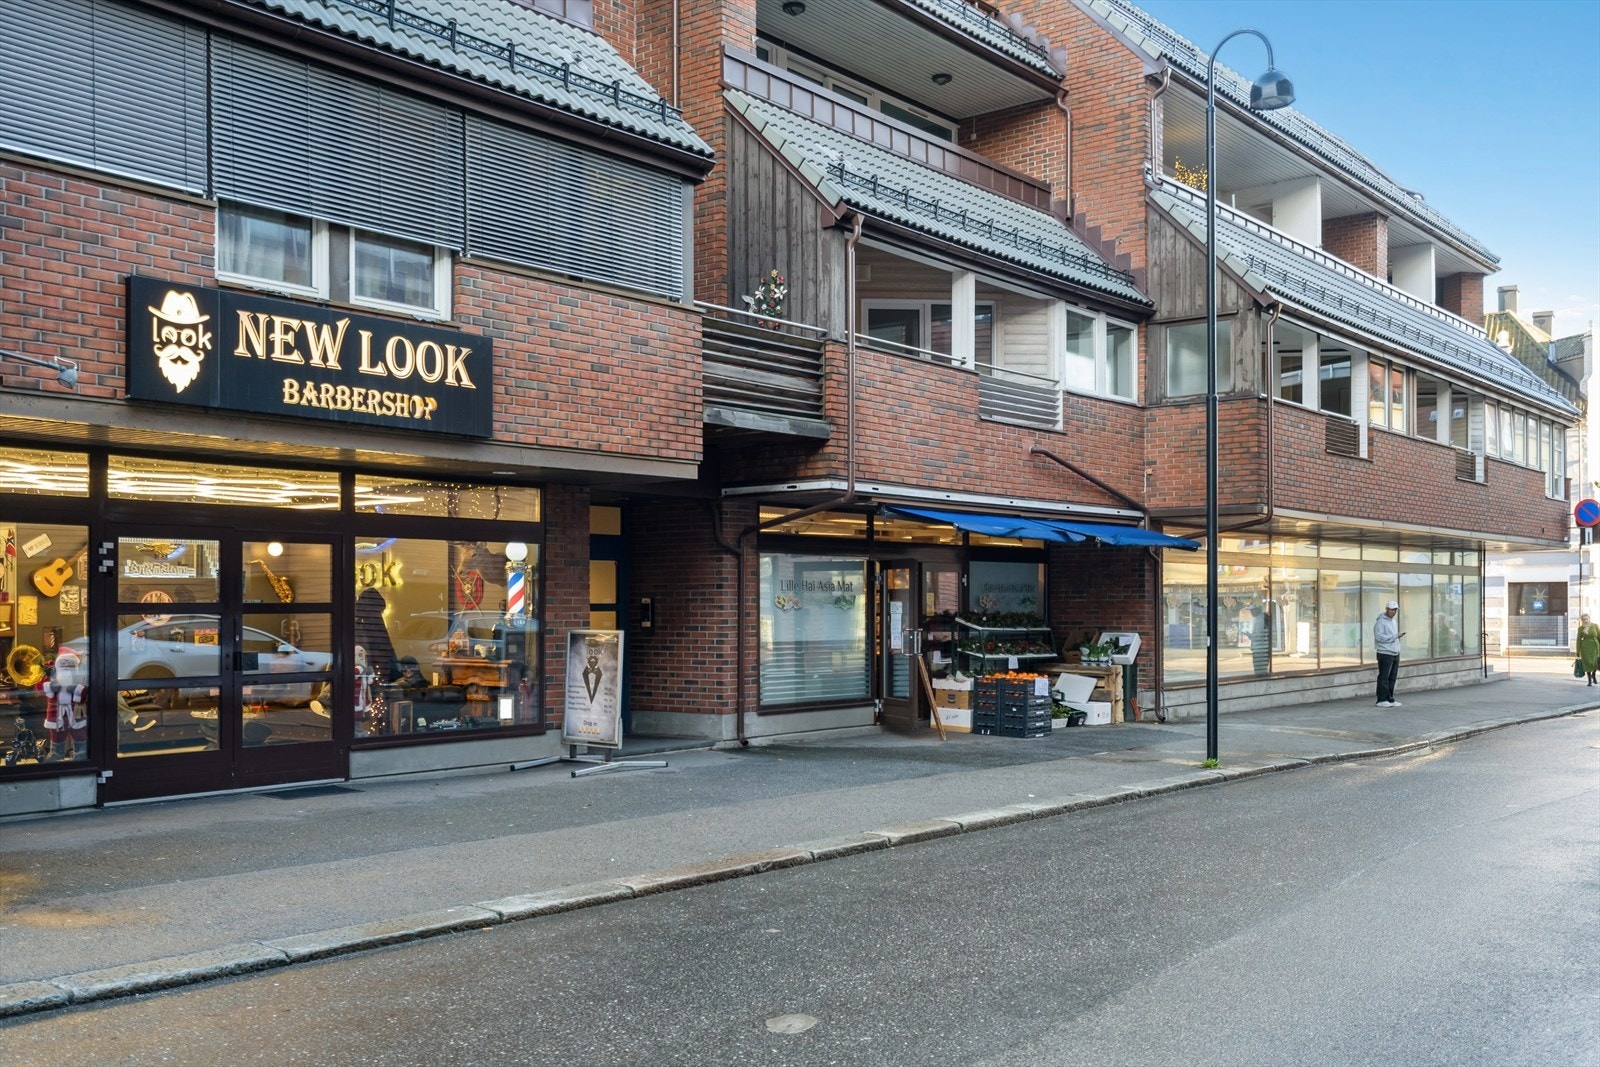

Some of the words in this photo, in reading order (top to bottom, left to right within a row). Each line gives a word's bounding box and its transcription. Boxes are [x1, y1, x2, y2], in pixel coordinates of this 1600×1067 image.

[152, 316, 213, 350] look
[234, 309, 350, 370] NEW
[358, 329, 477, 389] LOOK
[283, 378, 438, 420] BARBERSHOP
[780, 579, 800, 592] Lille
[801, 580, 816, 592] Hai
[818, 581, 836, 592] Asia
[838, 581, 854, 592] Mat
